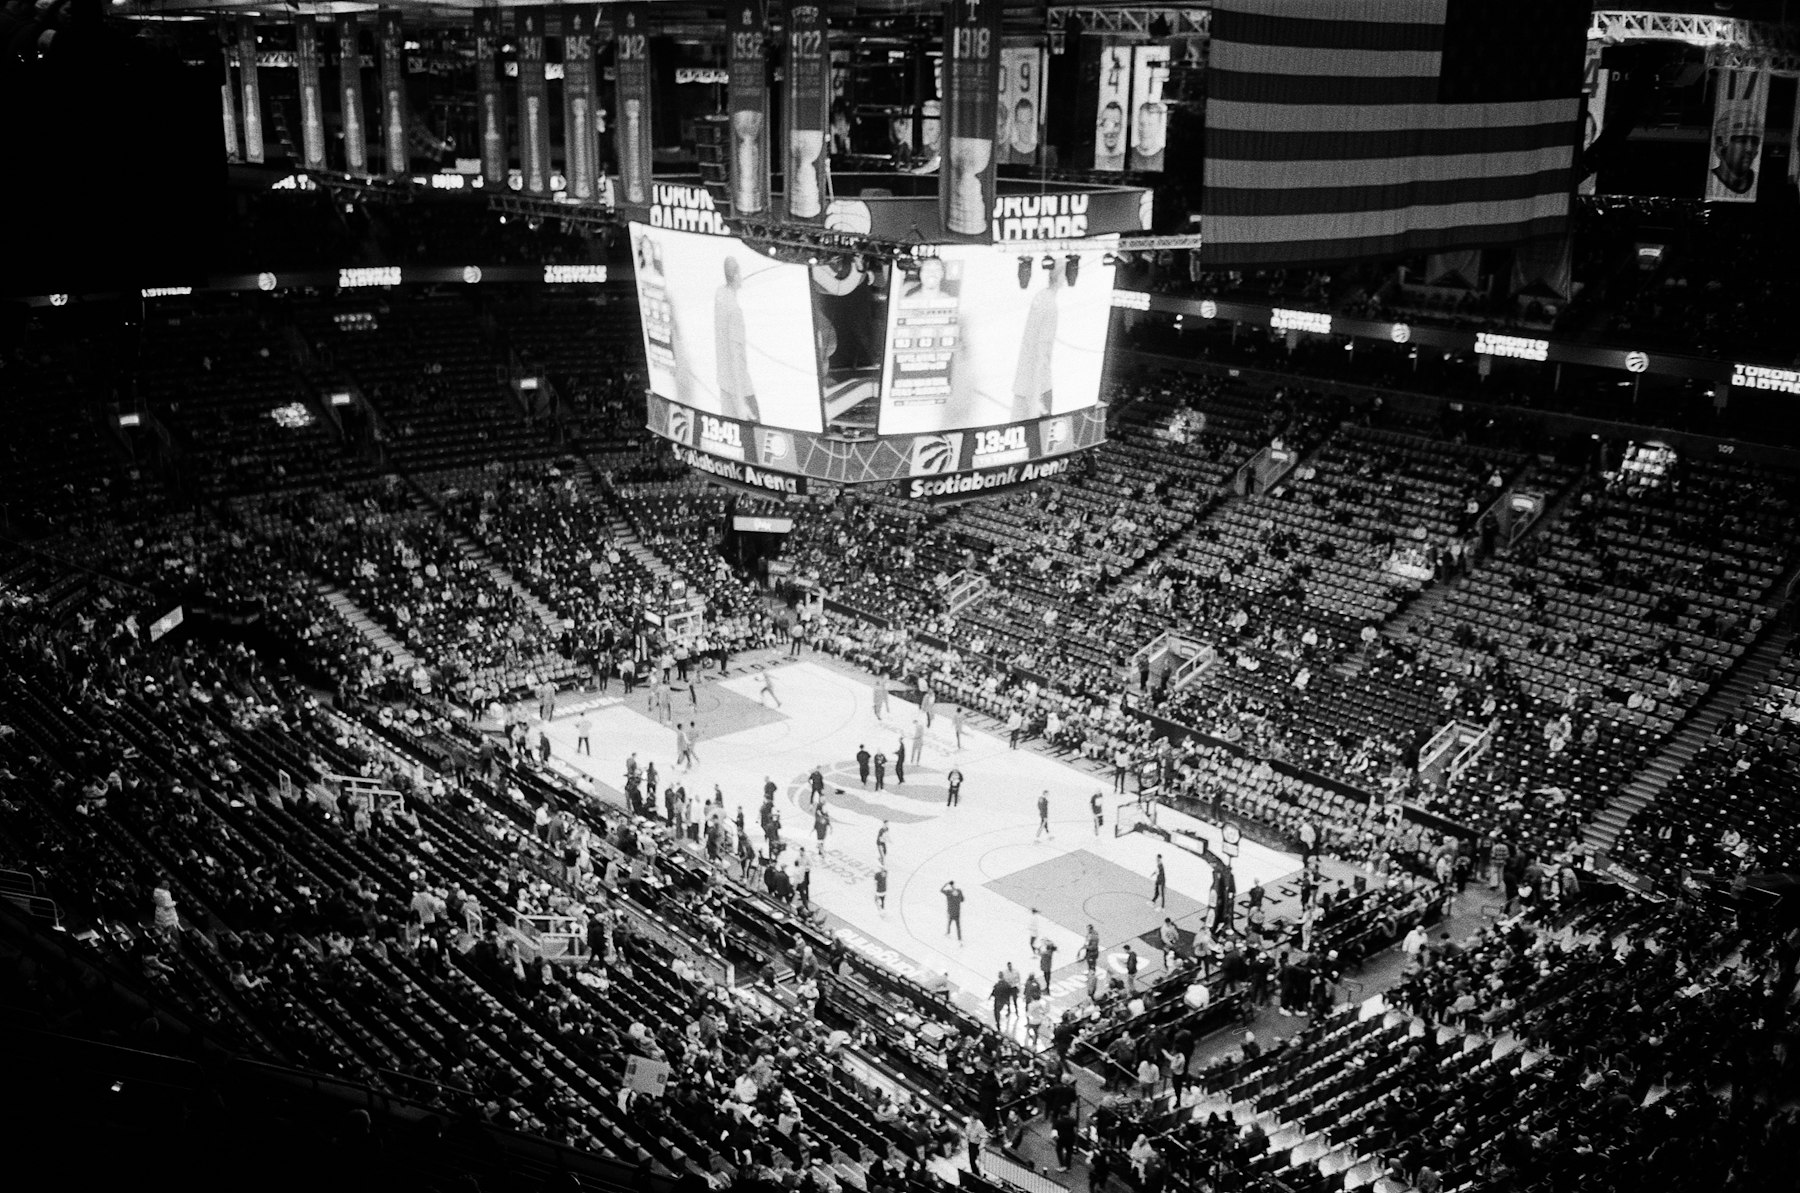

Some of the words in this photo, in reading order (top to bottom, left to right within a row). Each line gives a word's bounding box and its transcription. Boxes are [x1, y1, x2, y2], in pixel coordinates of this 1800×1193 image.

[952, 27, 990, 59] 1918
[1020, 62, 1030, 93] 9
[1476, 332, 1550, 351] TORONTO
[701, 415, 742, 447] 13:41
[974, 425, 1027, 455] 13:41
[672, 443, 744, 481] Scotiabank
[745, 466, 797, 494] Arena
[910, 466, 1018, 498] Scotiabank
[1020, 457, 1069, 482] Arena
